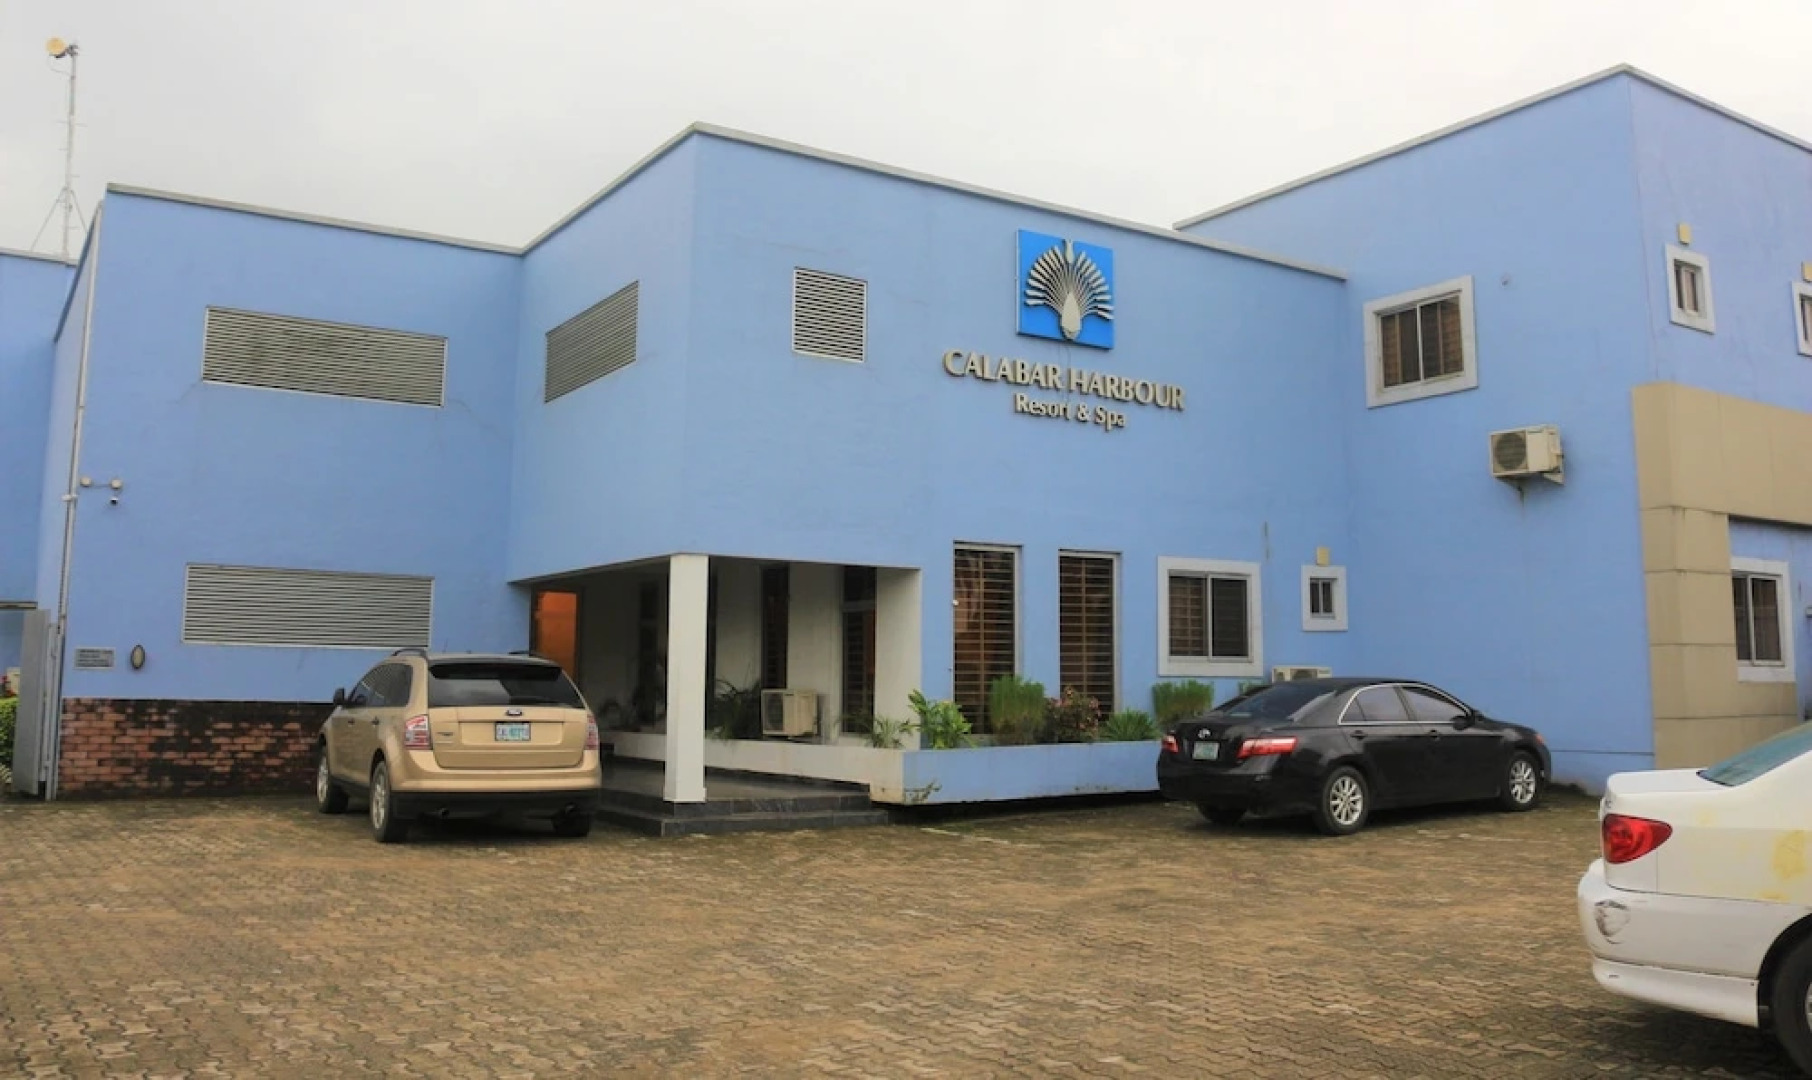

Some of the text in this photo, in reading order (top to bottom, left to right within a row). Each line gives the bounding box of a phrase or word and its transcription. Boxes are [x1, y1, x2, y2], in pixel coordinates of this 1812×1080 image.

[943, 349, 1187, 411] CALABAR HARBOUR
[1014, 392, 1127, 431] Resort & Spa
